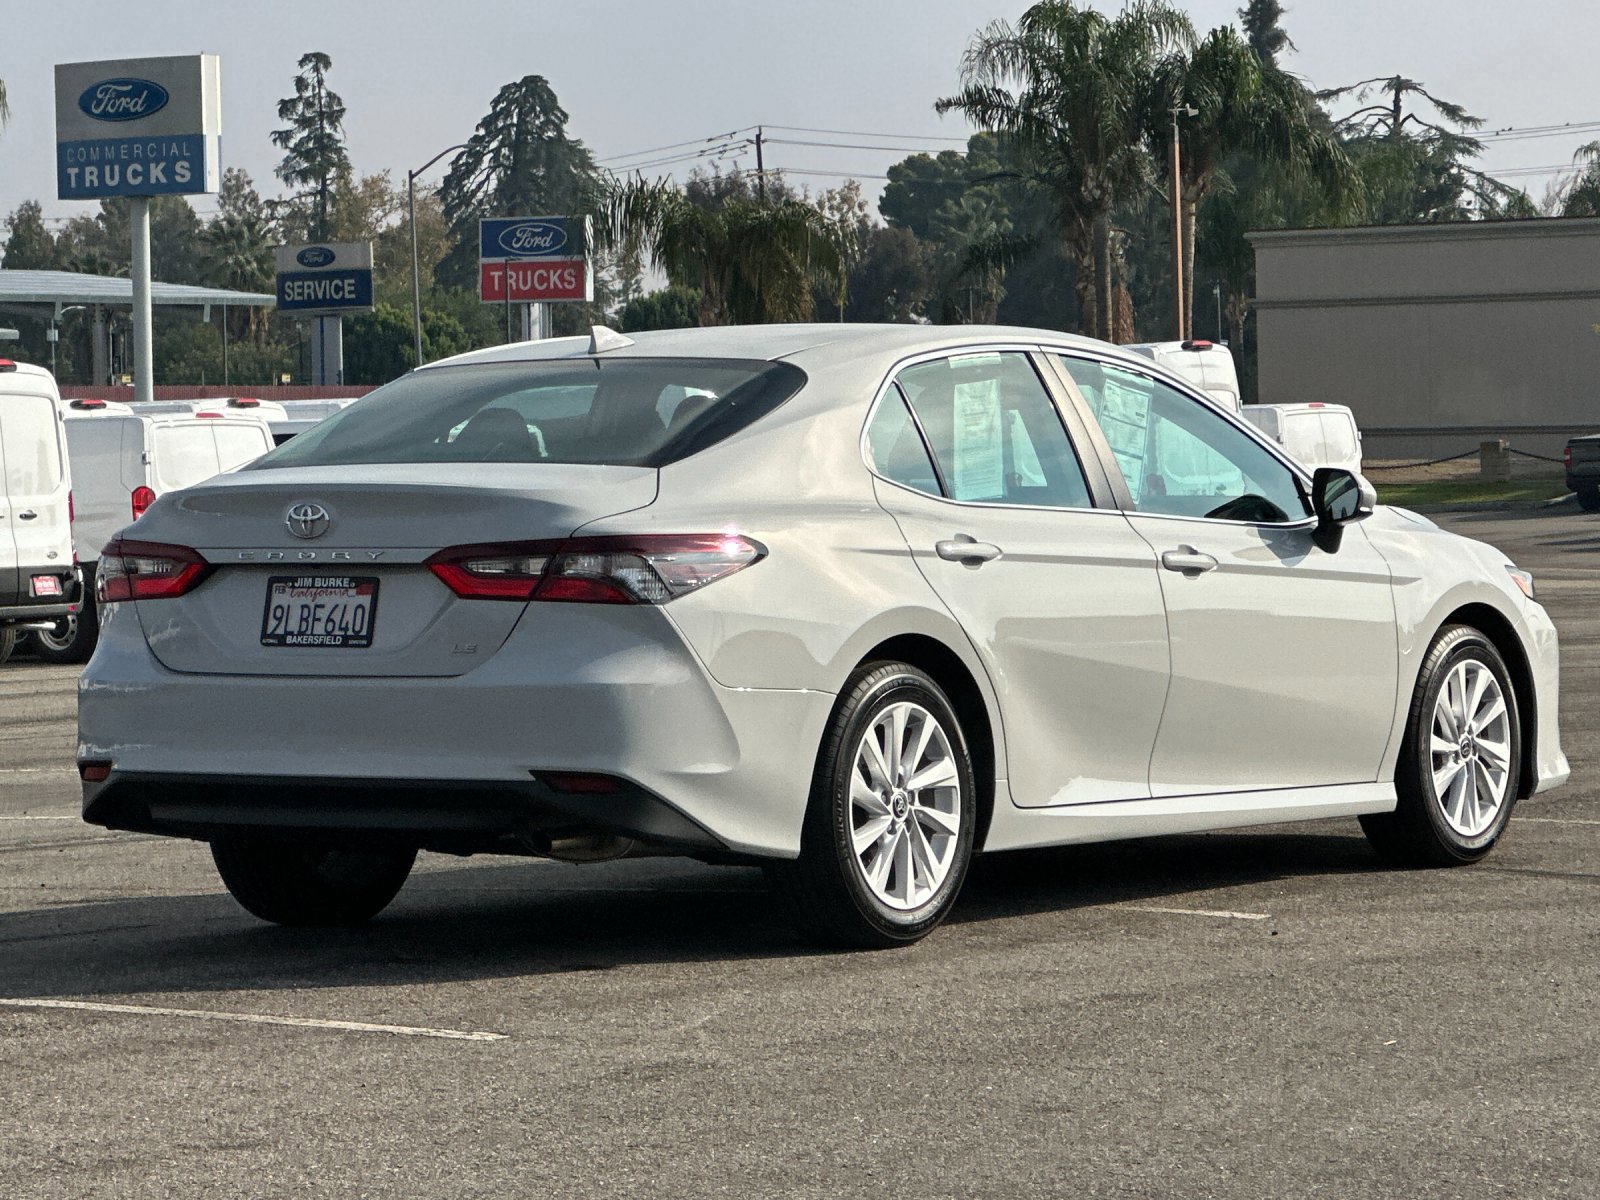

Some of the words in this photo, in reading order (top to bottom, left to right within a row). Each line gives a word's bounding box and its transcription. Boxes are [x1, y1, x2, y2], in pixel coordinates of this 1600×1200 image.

[91, 84, 148, 114] Ford
[66, 141, 191, 163] COMMERCIAL
[66, 160, 192, 189] TRUCKS
[511, 227, 554, 249] Ford
[284, 279, 356, 302] SERVICE
[490, 268, 577, 291] TRUCKS
[238, 551, 384, 560] CAMRY
[294, 578, 313, 588] JIM
[314, 578, 350, 588] BURKE
[268, 603, 366, 635] 9LBF640
[286, 635, 342, 645] BAKERSFIELD
